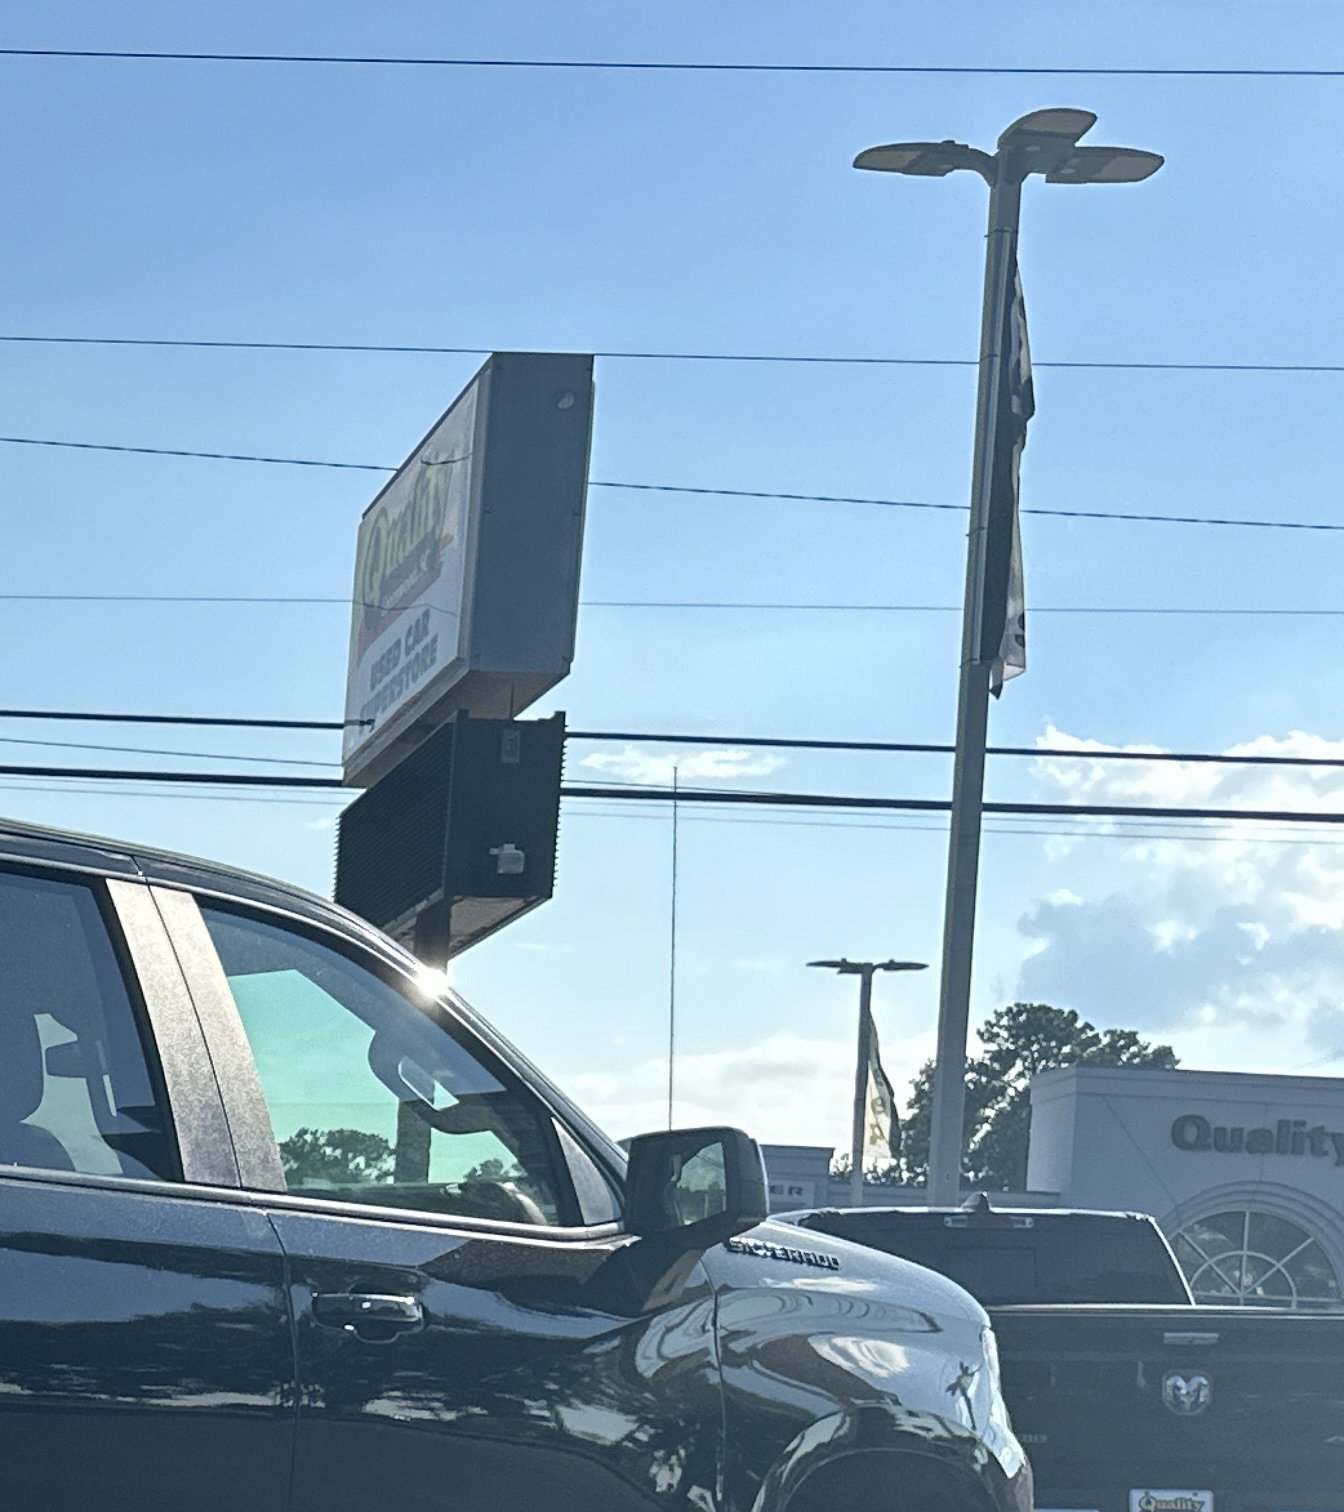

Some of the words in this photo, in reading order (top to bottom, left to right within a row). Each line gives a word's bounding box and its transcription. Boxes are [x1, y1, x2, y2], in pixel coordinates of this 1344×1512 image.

[363, 449, 454, 606] Quality
[359, 633, 439, 735] SUPERSTORE
[370, 637, 402, 692] USED
[405, 608, 430, 658] CAR
[728, 1237, 840, 1270] SILVERADO
[1138, 1495, 1205, 1512] Quality
